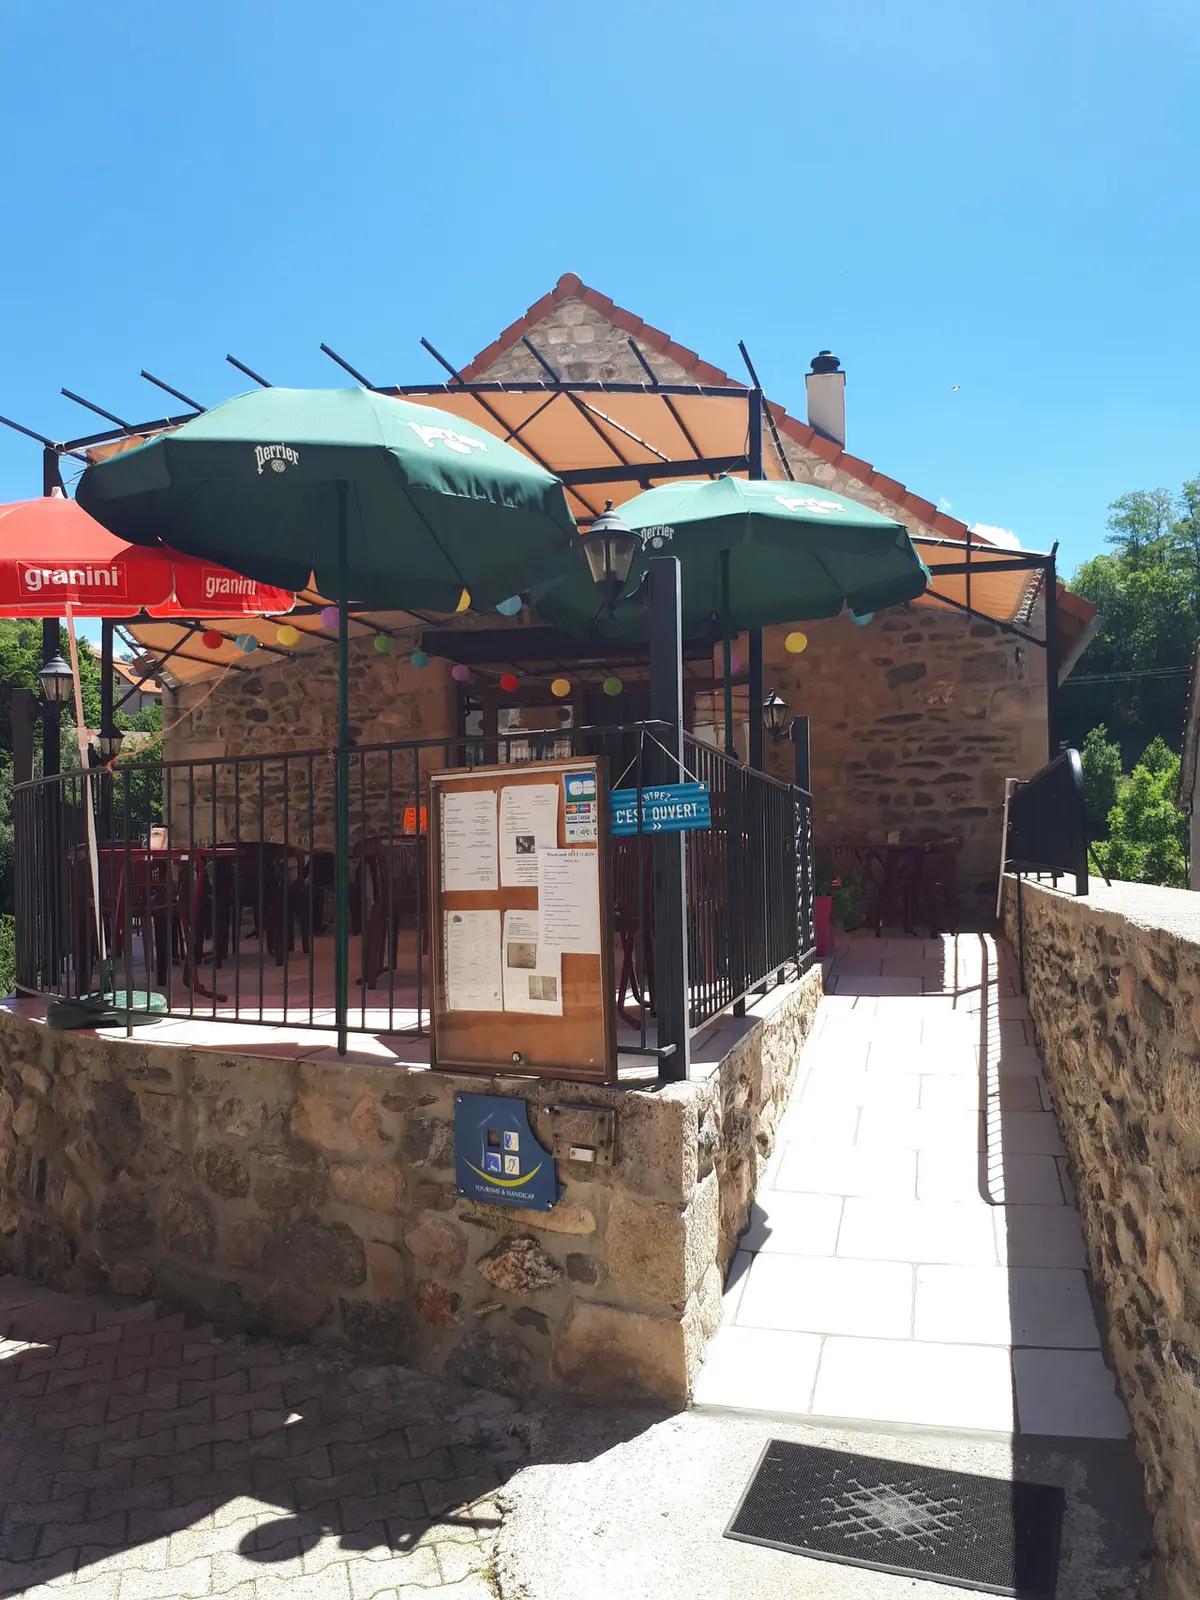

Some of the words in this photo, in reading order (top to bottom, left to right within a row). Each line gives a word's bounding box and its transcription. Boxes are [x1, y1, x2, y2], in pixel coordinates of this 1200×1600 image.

[24, 566, 119, 592] granini
[205, 575, 257, 599] granini
[652, 803, 698, 820] OUVERT
[474, 1184, 501, 1195] TOURISME
[506, 1189, 535, 1200] HANDICAP
